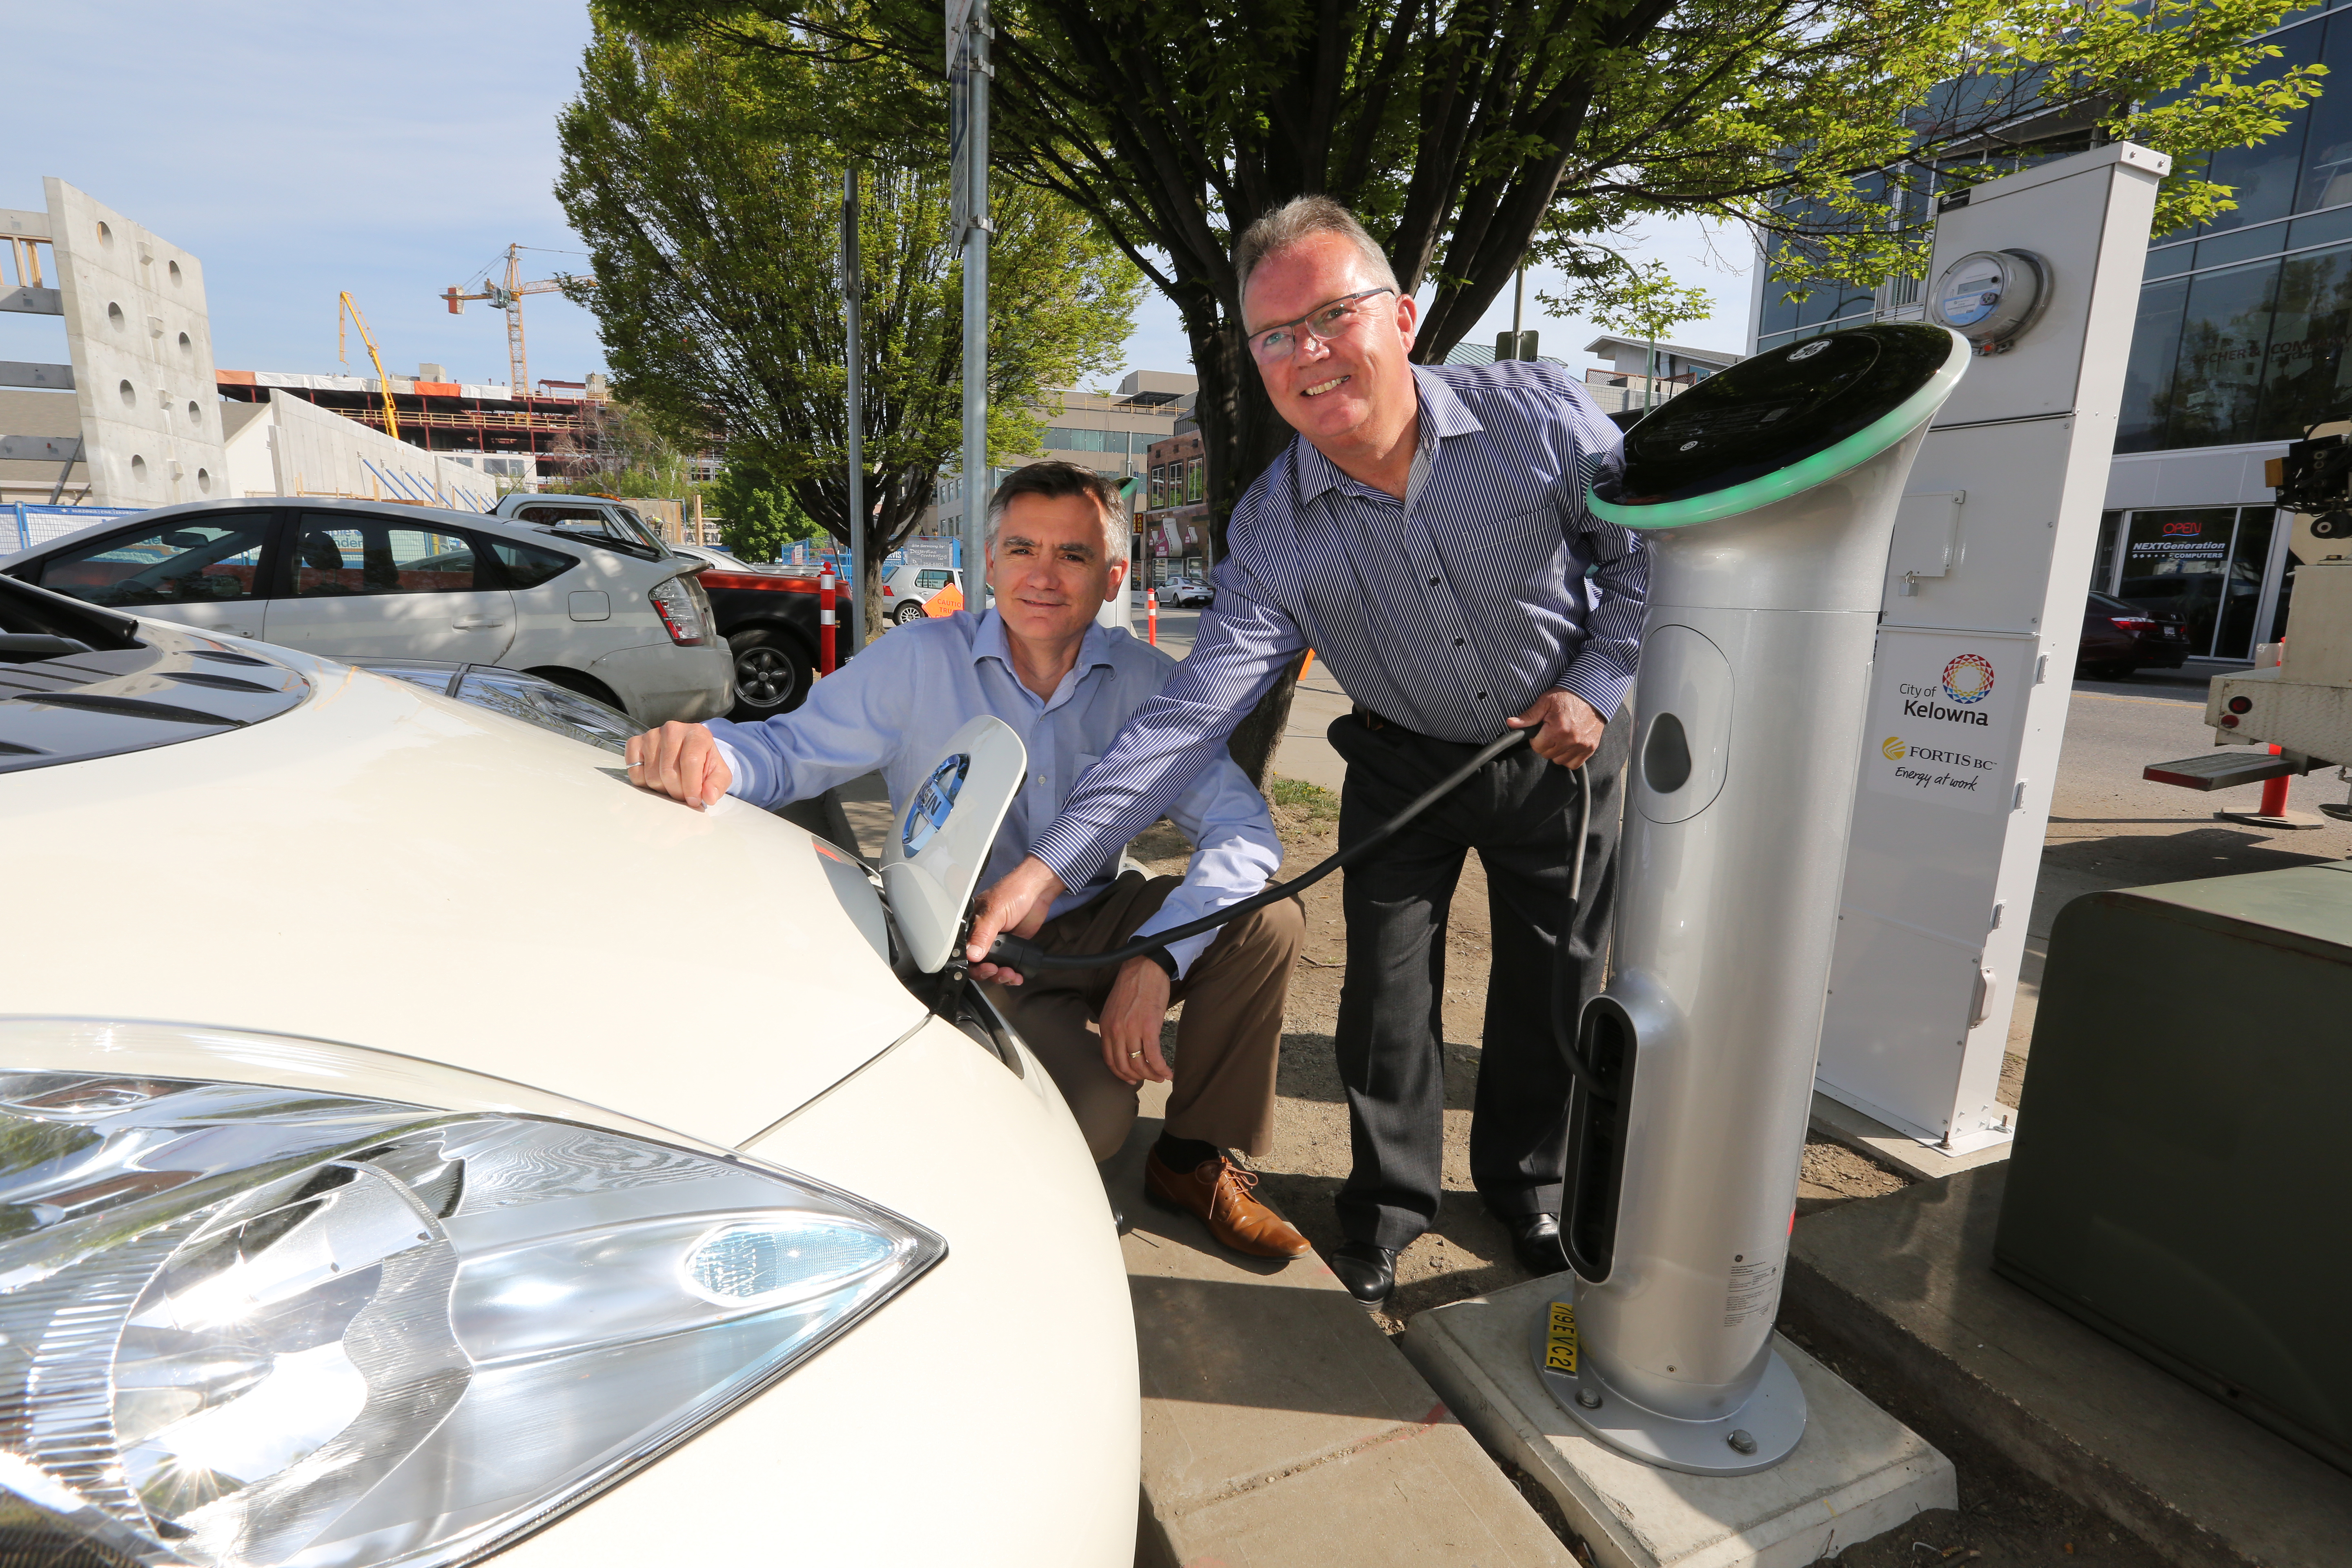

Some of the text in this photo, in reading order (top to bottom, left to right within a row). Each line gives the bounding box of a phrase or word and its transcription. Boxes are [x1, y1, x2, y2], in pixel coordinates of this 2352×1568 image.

[2163, 522, 2202, 533] OPEN
[2133, 541, 2225, 550] NEXTGeneration
[937, 599, 962, 608] CAUTIO
[1900, 684, 1937, 698] City of
[1904, 699, 1989, 726] Kelowna
[1909, 746, 1971, 766] FORTIS
[1895, 767, 1979, 791] Energy at work
